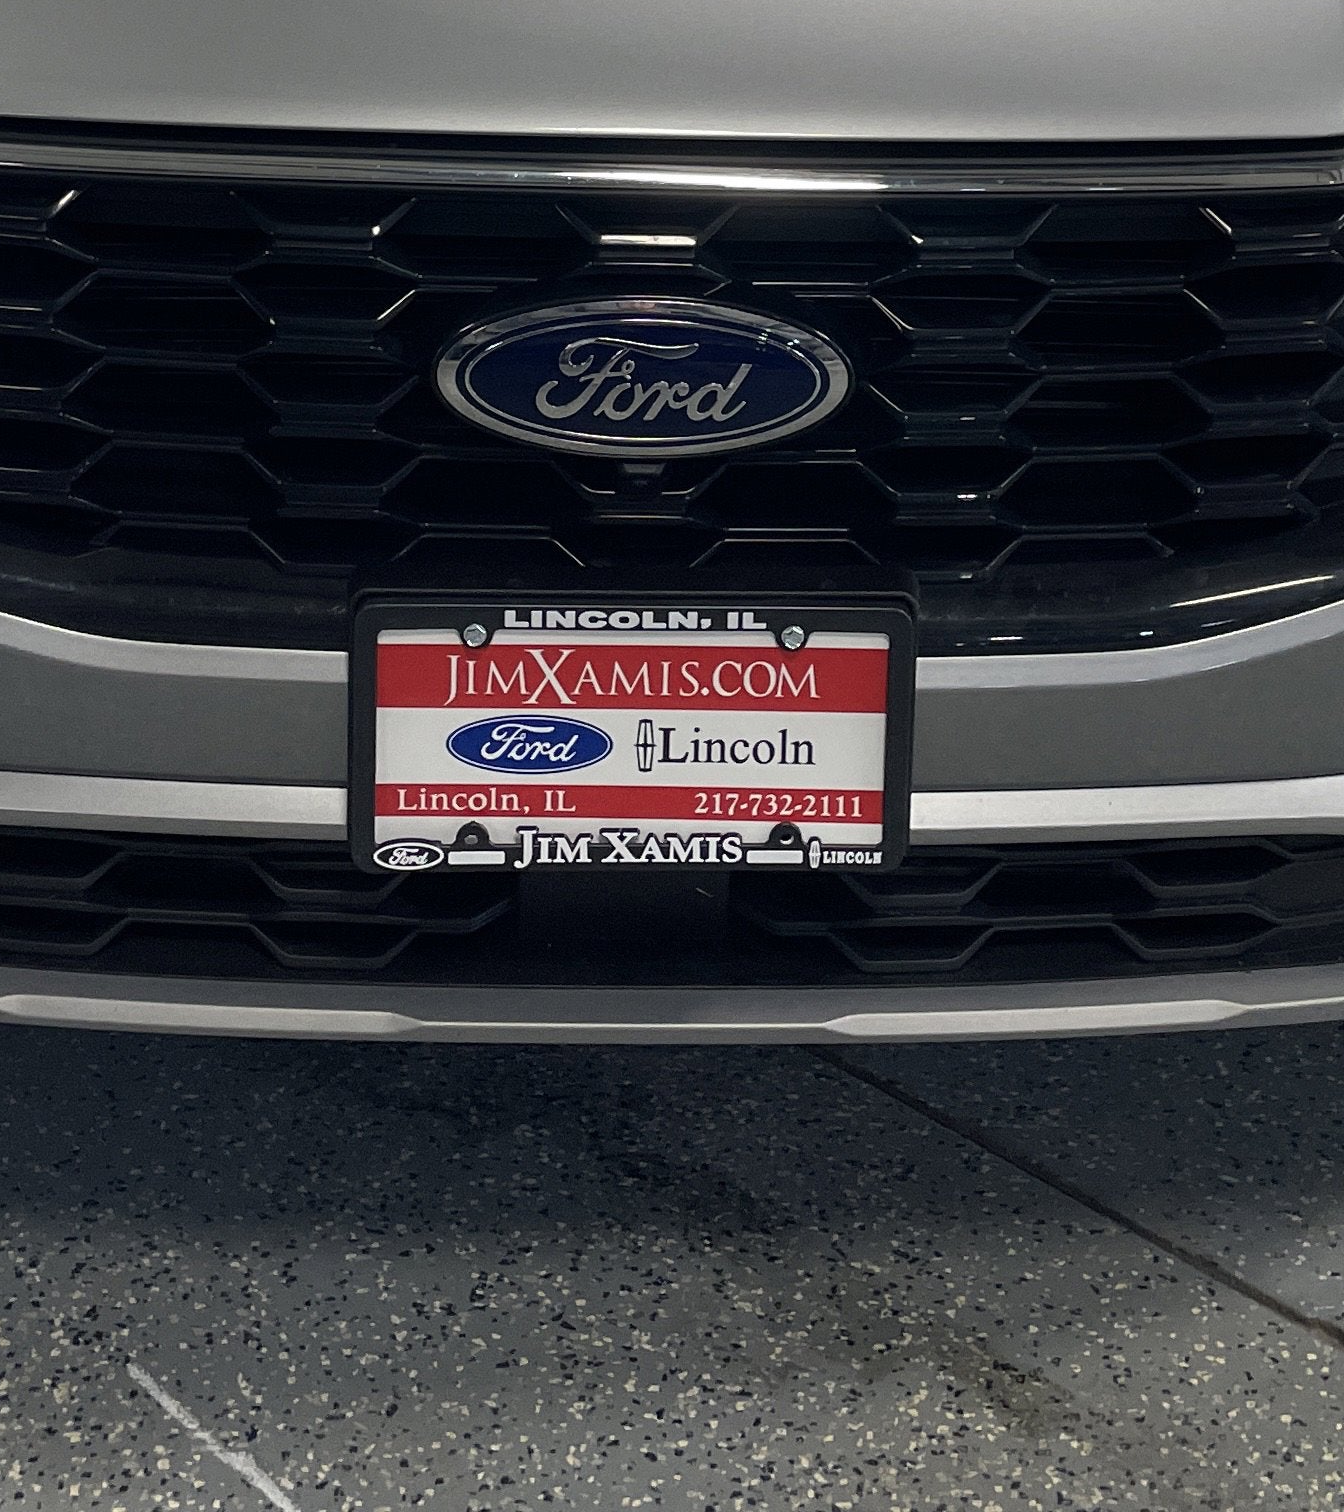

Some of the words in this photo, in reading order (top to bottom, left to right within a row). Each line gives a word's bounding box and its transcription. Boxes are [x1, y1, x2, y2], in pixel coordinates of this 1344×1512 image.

[535, 336, 753, 422] Ford
[503, 609, 712, 631] LINCOLN,
[726, 611, 767, 630] IL
[480, 723, 577, 763] Ford
[657, 727, 816, 766] Lincoln
[397, 788, 529, 814] Lincoln,
[543, 789, 576, 813] IL
[693, 792, 863, 818] 217-732-2111
[387, 846, 429, 866] Ford
[513, 826, 592, 868] JIM
[601, 828, 743, 865] XAMIS
[822, 850, 883, 865] LINCOLN
